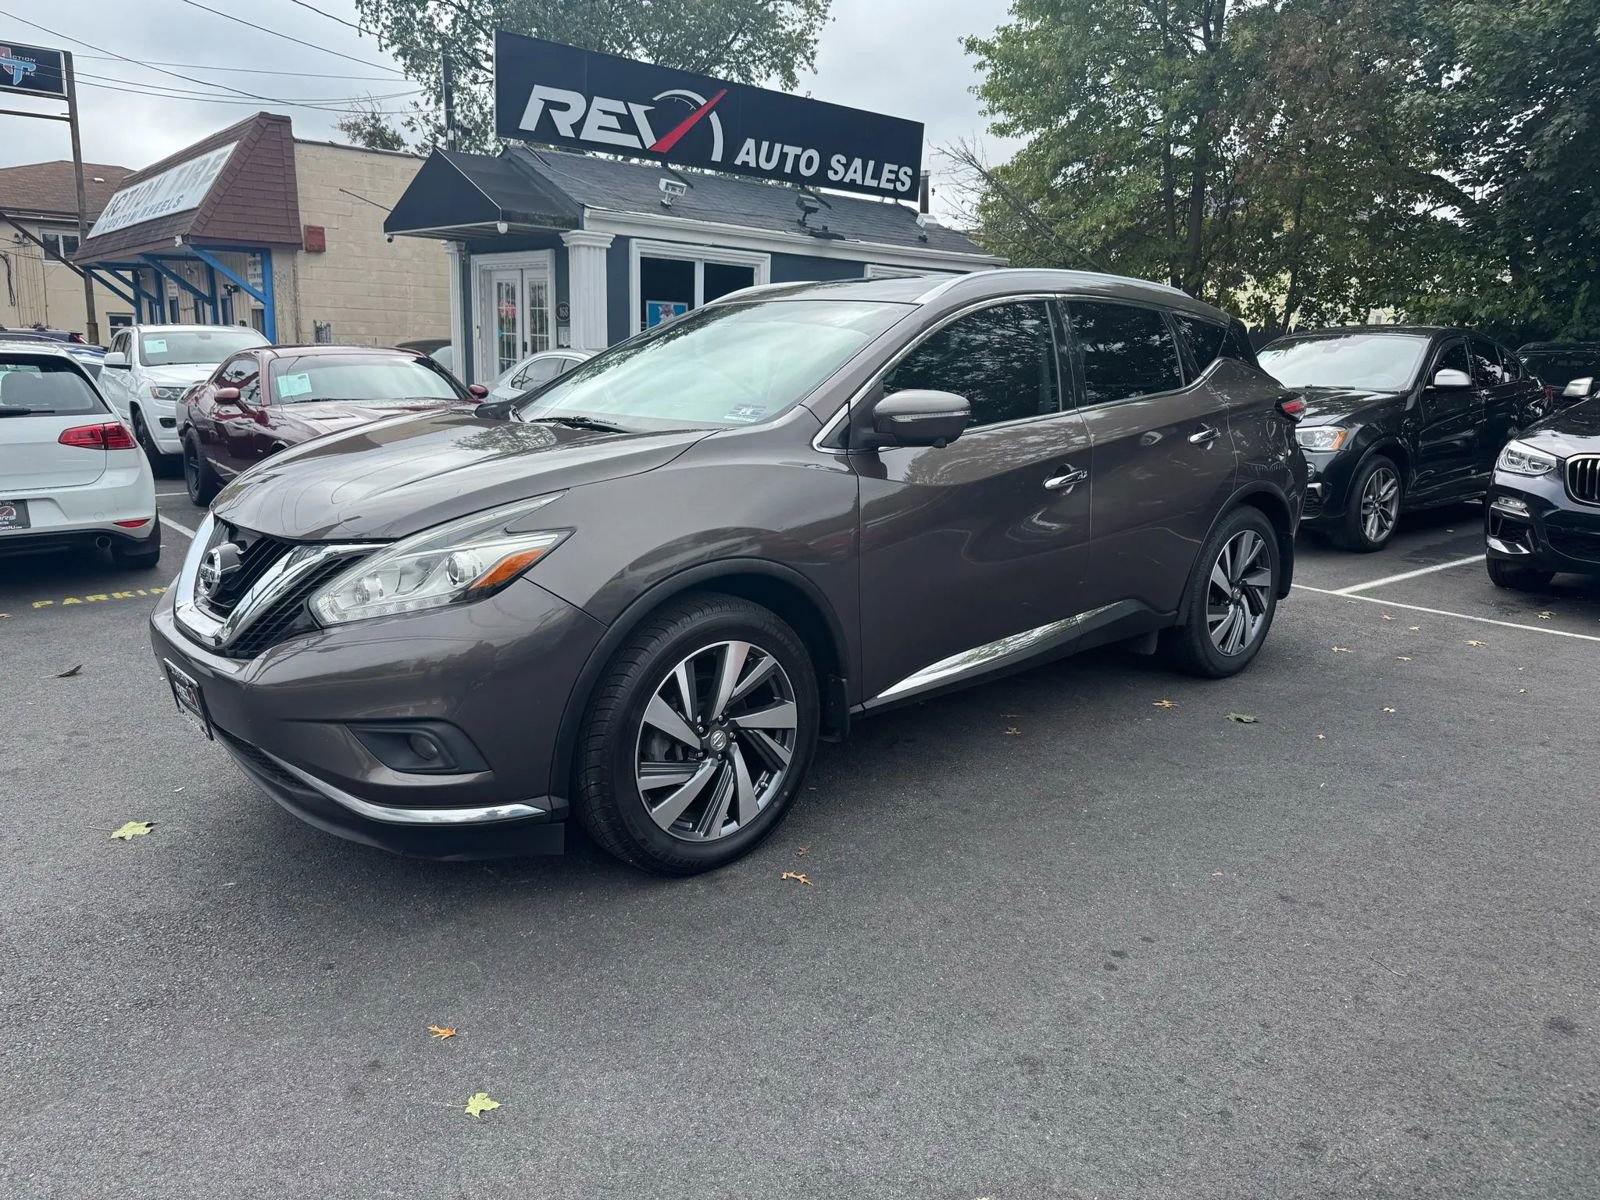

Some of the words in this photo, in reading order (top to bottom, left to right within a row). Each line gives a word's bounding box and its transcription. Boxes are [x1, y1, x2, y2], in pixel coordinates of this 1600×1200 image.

[518, 84, 727, 154] REX
[101, 175, 168, 219] ACTION
[166, 149, 230, 196] TIRE
[734, 138, 820, 177] AUTO
[827, 154, 913, 192] SALES
[137, 193, 185, 220] WHEELS
[32, 586, 168, 609] PARKIN
